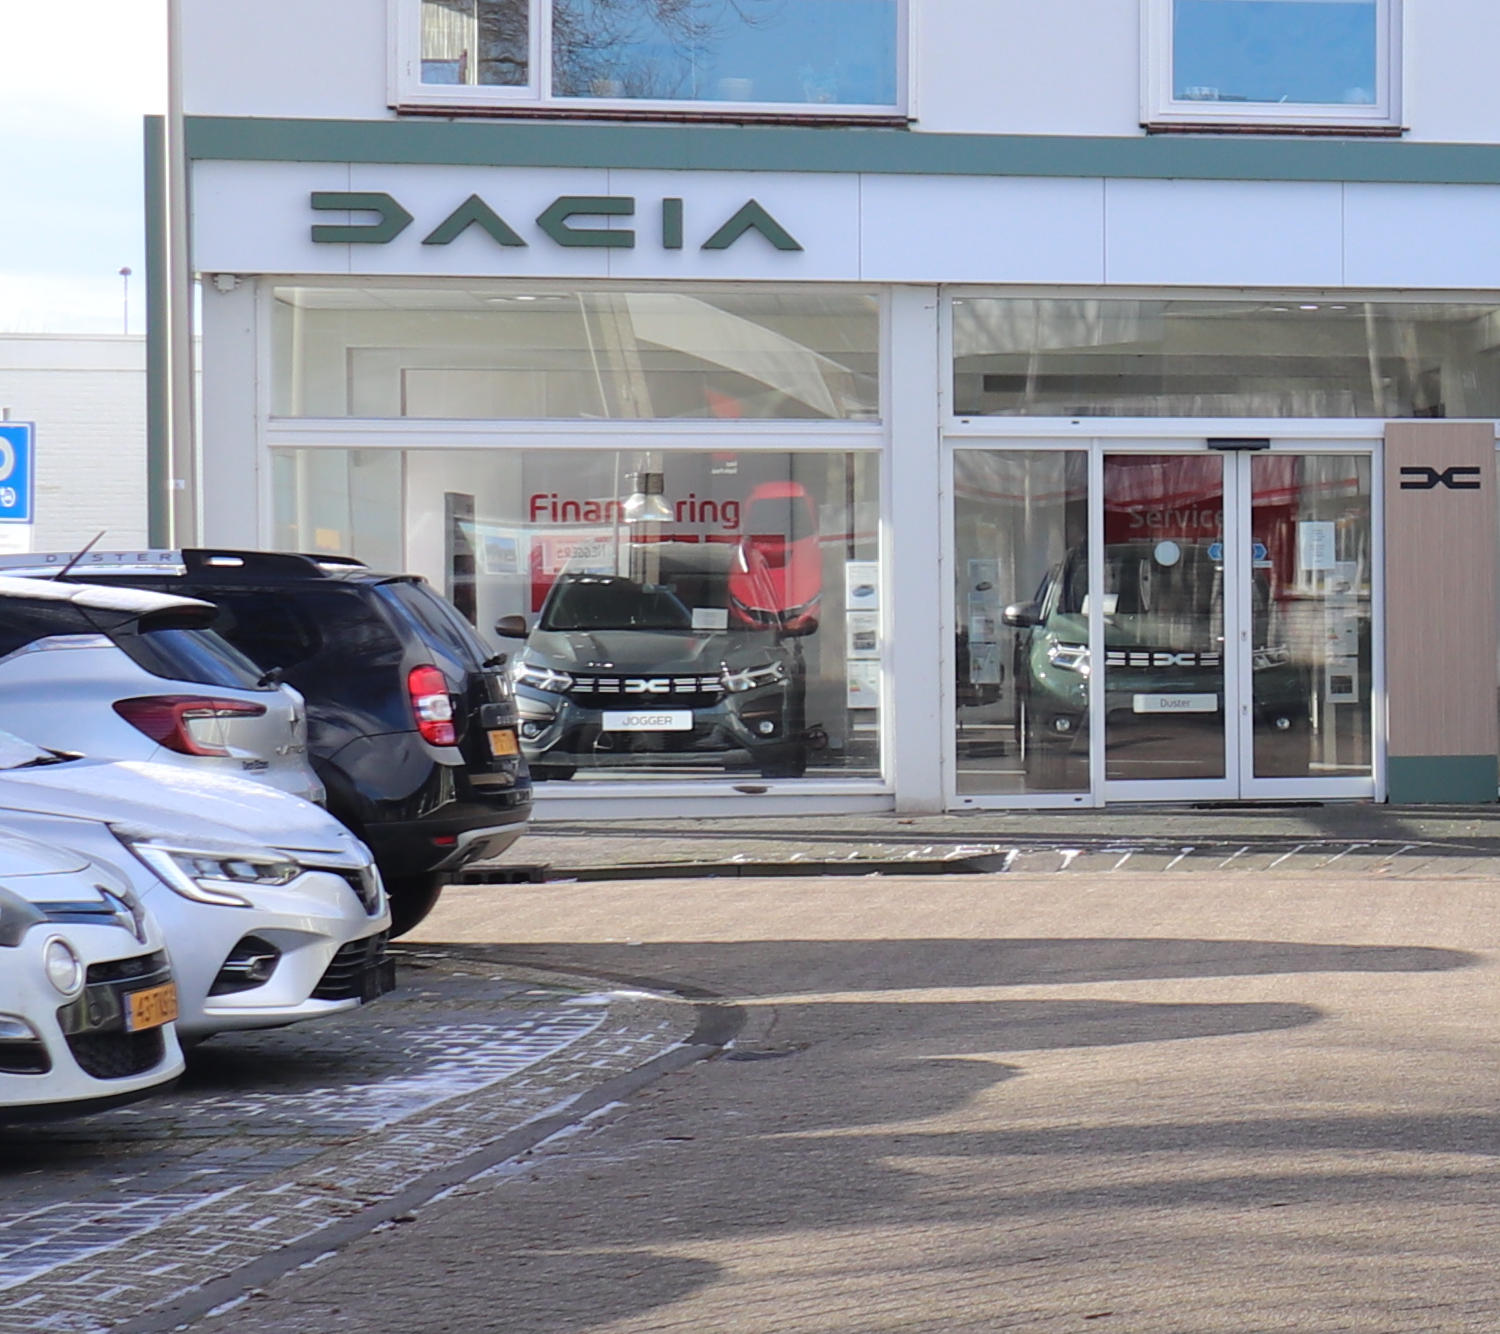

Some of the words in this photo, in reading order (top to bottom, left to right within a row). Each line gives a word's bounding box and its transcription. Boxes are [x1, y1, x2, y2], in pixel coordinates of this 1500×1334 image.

[311, 191, 804, 251] DACIA
[529, 493, 741, 530] Finanring
[1160, 697, 1191, 708] Duster
[622, 716, 673, 726] JOGGER
